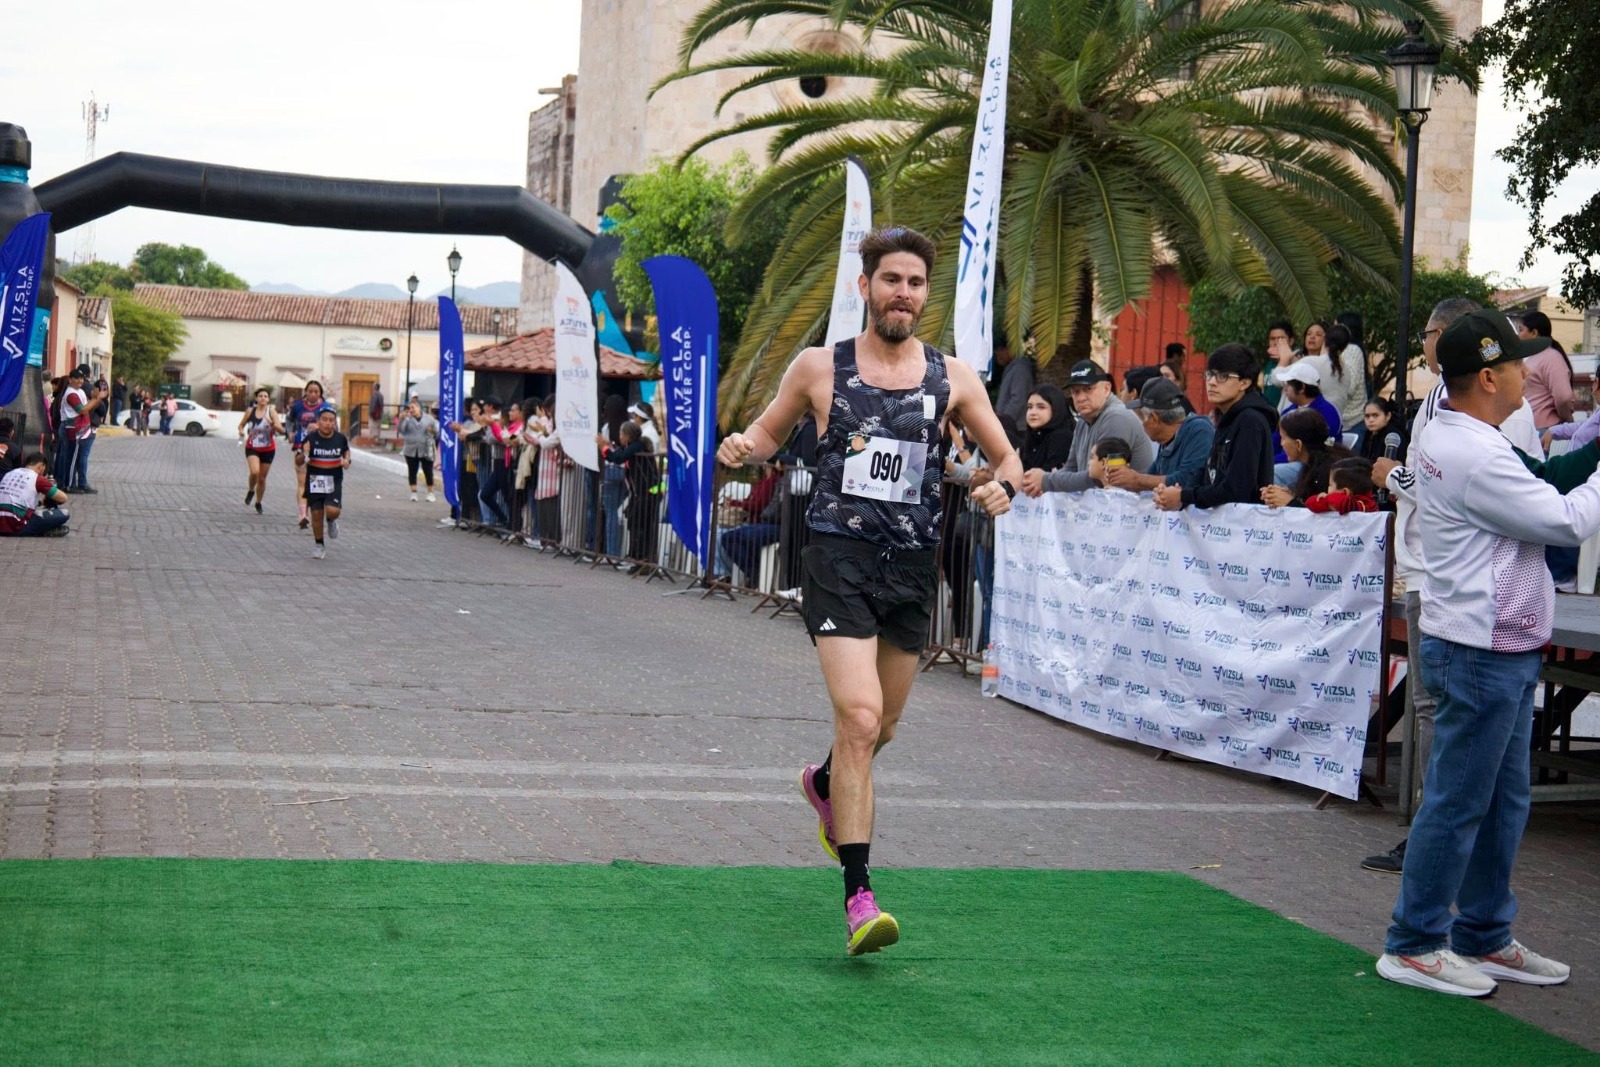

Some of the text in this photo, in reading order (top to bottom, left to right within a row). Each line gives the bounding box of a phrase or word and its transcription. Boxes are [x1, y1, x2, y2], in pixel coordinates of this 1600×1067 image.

[8, 265, 29, 336] VIZSLA
[670, 326, 687, 433] VIZSLA
[684, 327, 693, 429] SILVER CORP.
[443, 349, 451, 427] VIZSLA
[870, 451, 903, 483] 090
[1210, 525, 1231, 537] VIZSLA
[1253, 530, 1275, 541] VIZSLA
[1291, 533, 1313, 543] VIZSLA
[1338, 536, 1364, 546] VIZSLA
[1227, 564, 1248, 576] VIZSLA
[1271, 570, 1290, 581] VIZSLA
[1314, 574, 1342, 585] VIZSLA
[1360, 575, 1384, 586] VIZS
[1160, 586, 1180, 598] VIZSLA
[1203, 594, 1227, 606] VIZSLA
[1246, 602, 1266, 613] VIZSLA
[1137, 617, 1154, 628] VIZSLA
[1522, 615, 1536, 627] KD
[1170, 624, 1190, 635] VIZSLA
[1213, 633, 1238, 645] VIZSLA
[1148, 652, 1167, 664] VIZSLA
[1182, 660, 1202, 673] VIZSLA
[1221, 668, 1244, 682] VIZSLA
[1130, 683, 1150, 695] VIZSLA
[1267, 678, 1296, 690] VIZSLA
[1323, 685, 1356, 698] VIZSLA
[1166, 692, 1186, 704] VIZSLA
[1206, 701, 1228, 713] VIZSLA
[1251, 710, 1277, 723] VIZSLA
[1141, 720, 1160, 732] VIZSLA
[1300, 721, 1331, 733] VIZSLA
[1181, 730, 1206, 742] VIZSLA
[1228, 739, 1248, 752] VIZSLA
[1272, 749, 1301, 763] VIZSLA
[1324, 760, 1344, 774] VIZSLA
